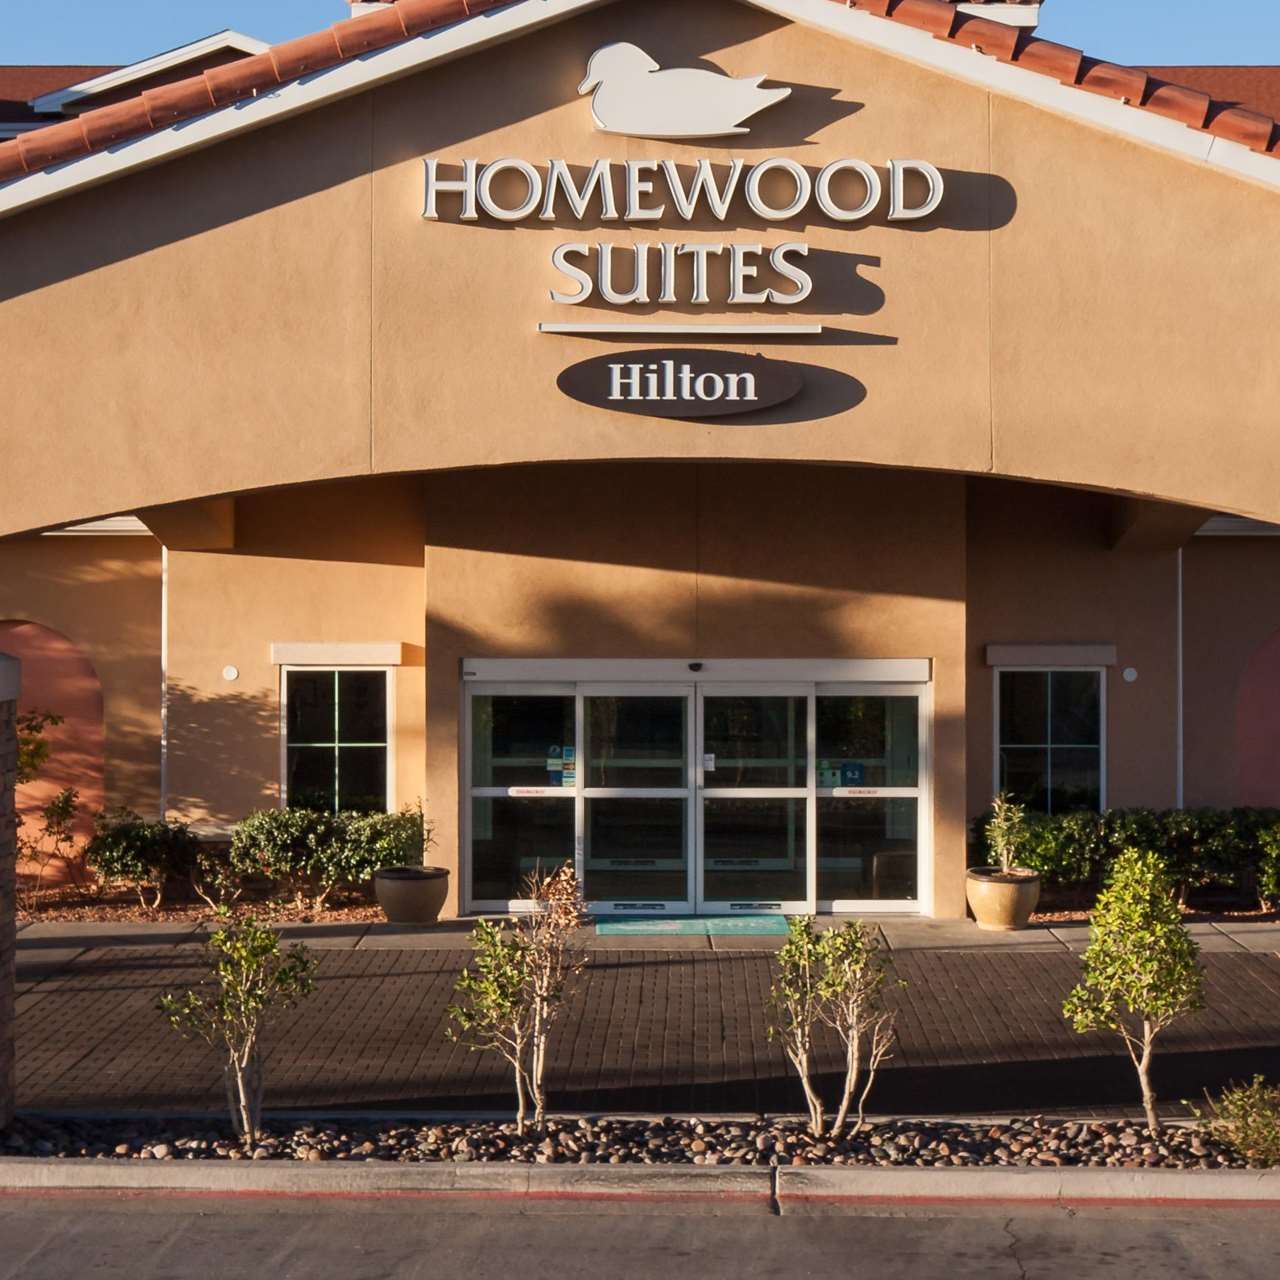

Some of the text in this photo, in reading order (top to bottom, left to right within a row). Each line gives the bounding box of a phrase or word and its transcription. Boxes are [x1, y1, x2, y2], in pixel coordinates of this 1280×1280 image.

[421, 158, 944, 221] HOMEWOOD
[550, 243, 813, 304] SUITES
[607, 361, 758, 401] Hilton
